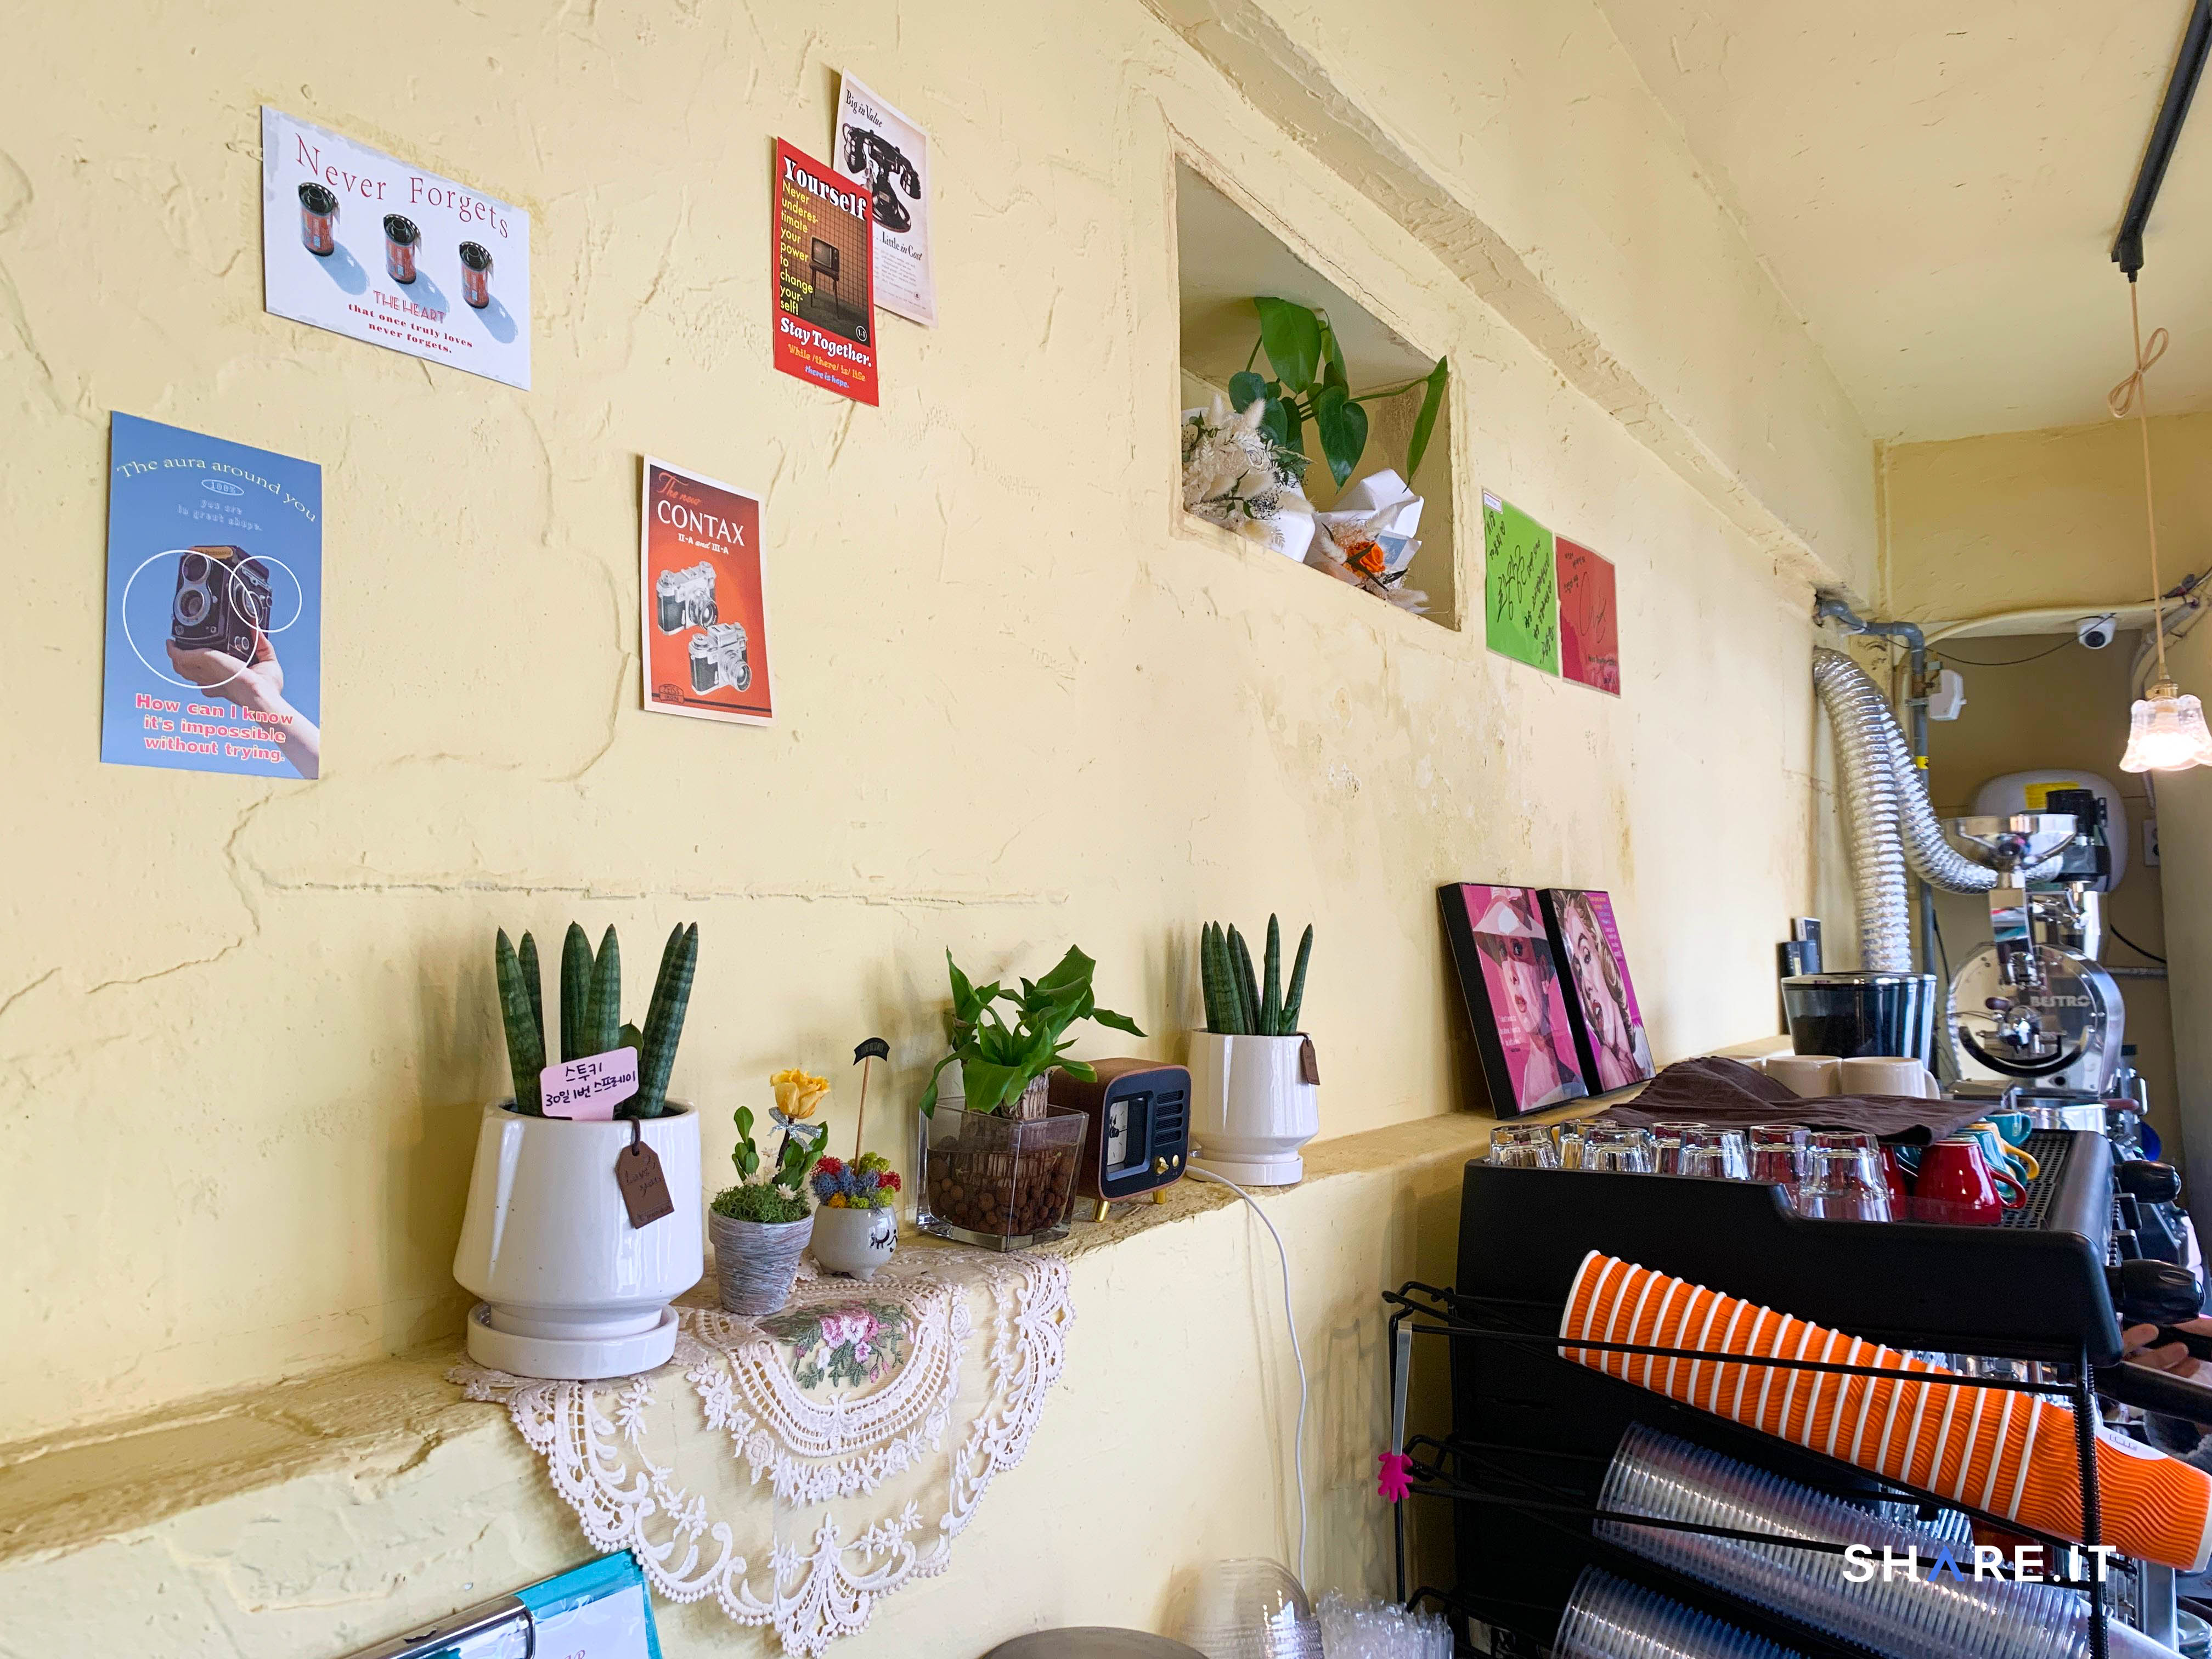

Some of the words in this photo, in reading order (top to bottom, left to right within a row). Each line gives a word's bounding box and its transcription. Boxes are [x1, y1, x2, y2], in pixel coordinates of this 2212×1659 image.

[846, 89, 857, 114] Big
[857, 103, 866, 114] in
[865, 104, 883, 128] Value
[296, 133, 386, 200] Never
[409, 177, 508, 239] Forgets
[782, 182, 810, 205] Never
[783, 155, 867, 221] Yourself
[781, 210, 808, 233] timate
[782, 198, 818, 223] underes-
[781, 227, 801, 244] your
[780, 254, 789, 267] to
[781, 241, 809, 262] power
[900, 244, 908, 254] in
[908, 245, 922, 261] Cost
[780, 268, 814, 294] change
[780, 285, 803, 301] your-
[373, 290, 400, 310] THE
[403, 300, 446, 324] HEART
[780, 298, 799, 316] self!
[348, 303, 375, 318] that
[379, 313, 407, 328] once
[410, 320, 440, 338] truly
[444, 331, 473, 348] loves
[368, 323, 402, 338] never
[407, 333, 452, 354] forgets.
[780, 317, 811, 346] Stay
[812, 330, 872, 367] Together.
[788, 343, 811, 360] While
[852, 369, 866, 382] life
[116, 461, 158, 478] The
[164, 459, 206, 469] aura
[212, 462, 281, 495] around
[284, 494, 317, 522] you
[657, 471, 689, 499] The
[657, 500, 745, 546] CONTAX
[678, 533, 694, 545] II-A
[695, 540, 711, 550] and
[712, 543, 729, 555] III-A
[136, 693, 180, 712] How
[187, 702, 224, 718] can
[230, 705, 236, 719] I
[243, 706, 293, 725] know
[144, 714, 174, 731] it's
[180, 719, 286, 743] impossible
[145, 736, 219, 755] without
[225, 742, 285, 764] trying.
[566, 1062, 602, 1082] 스투키
